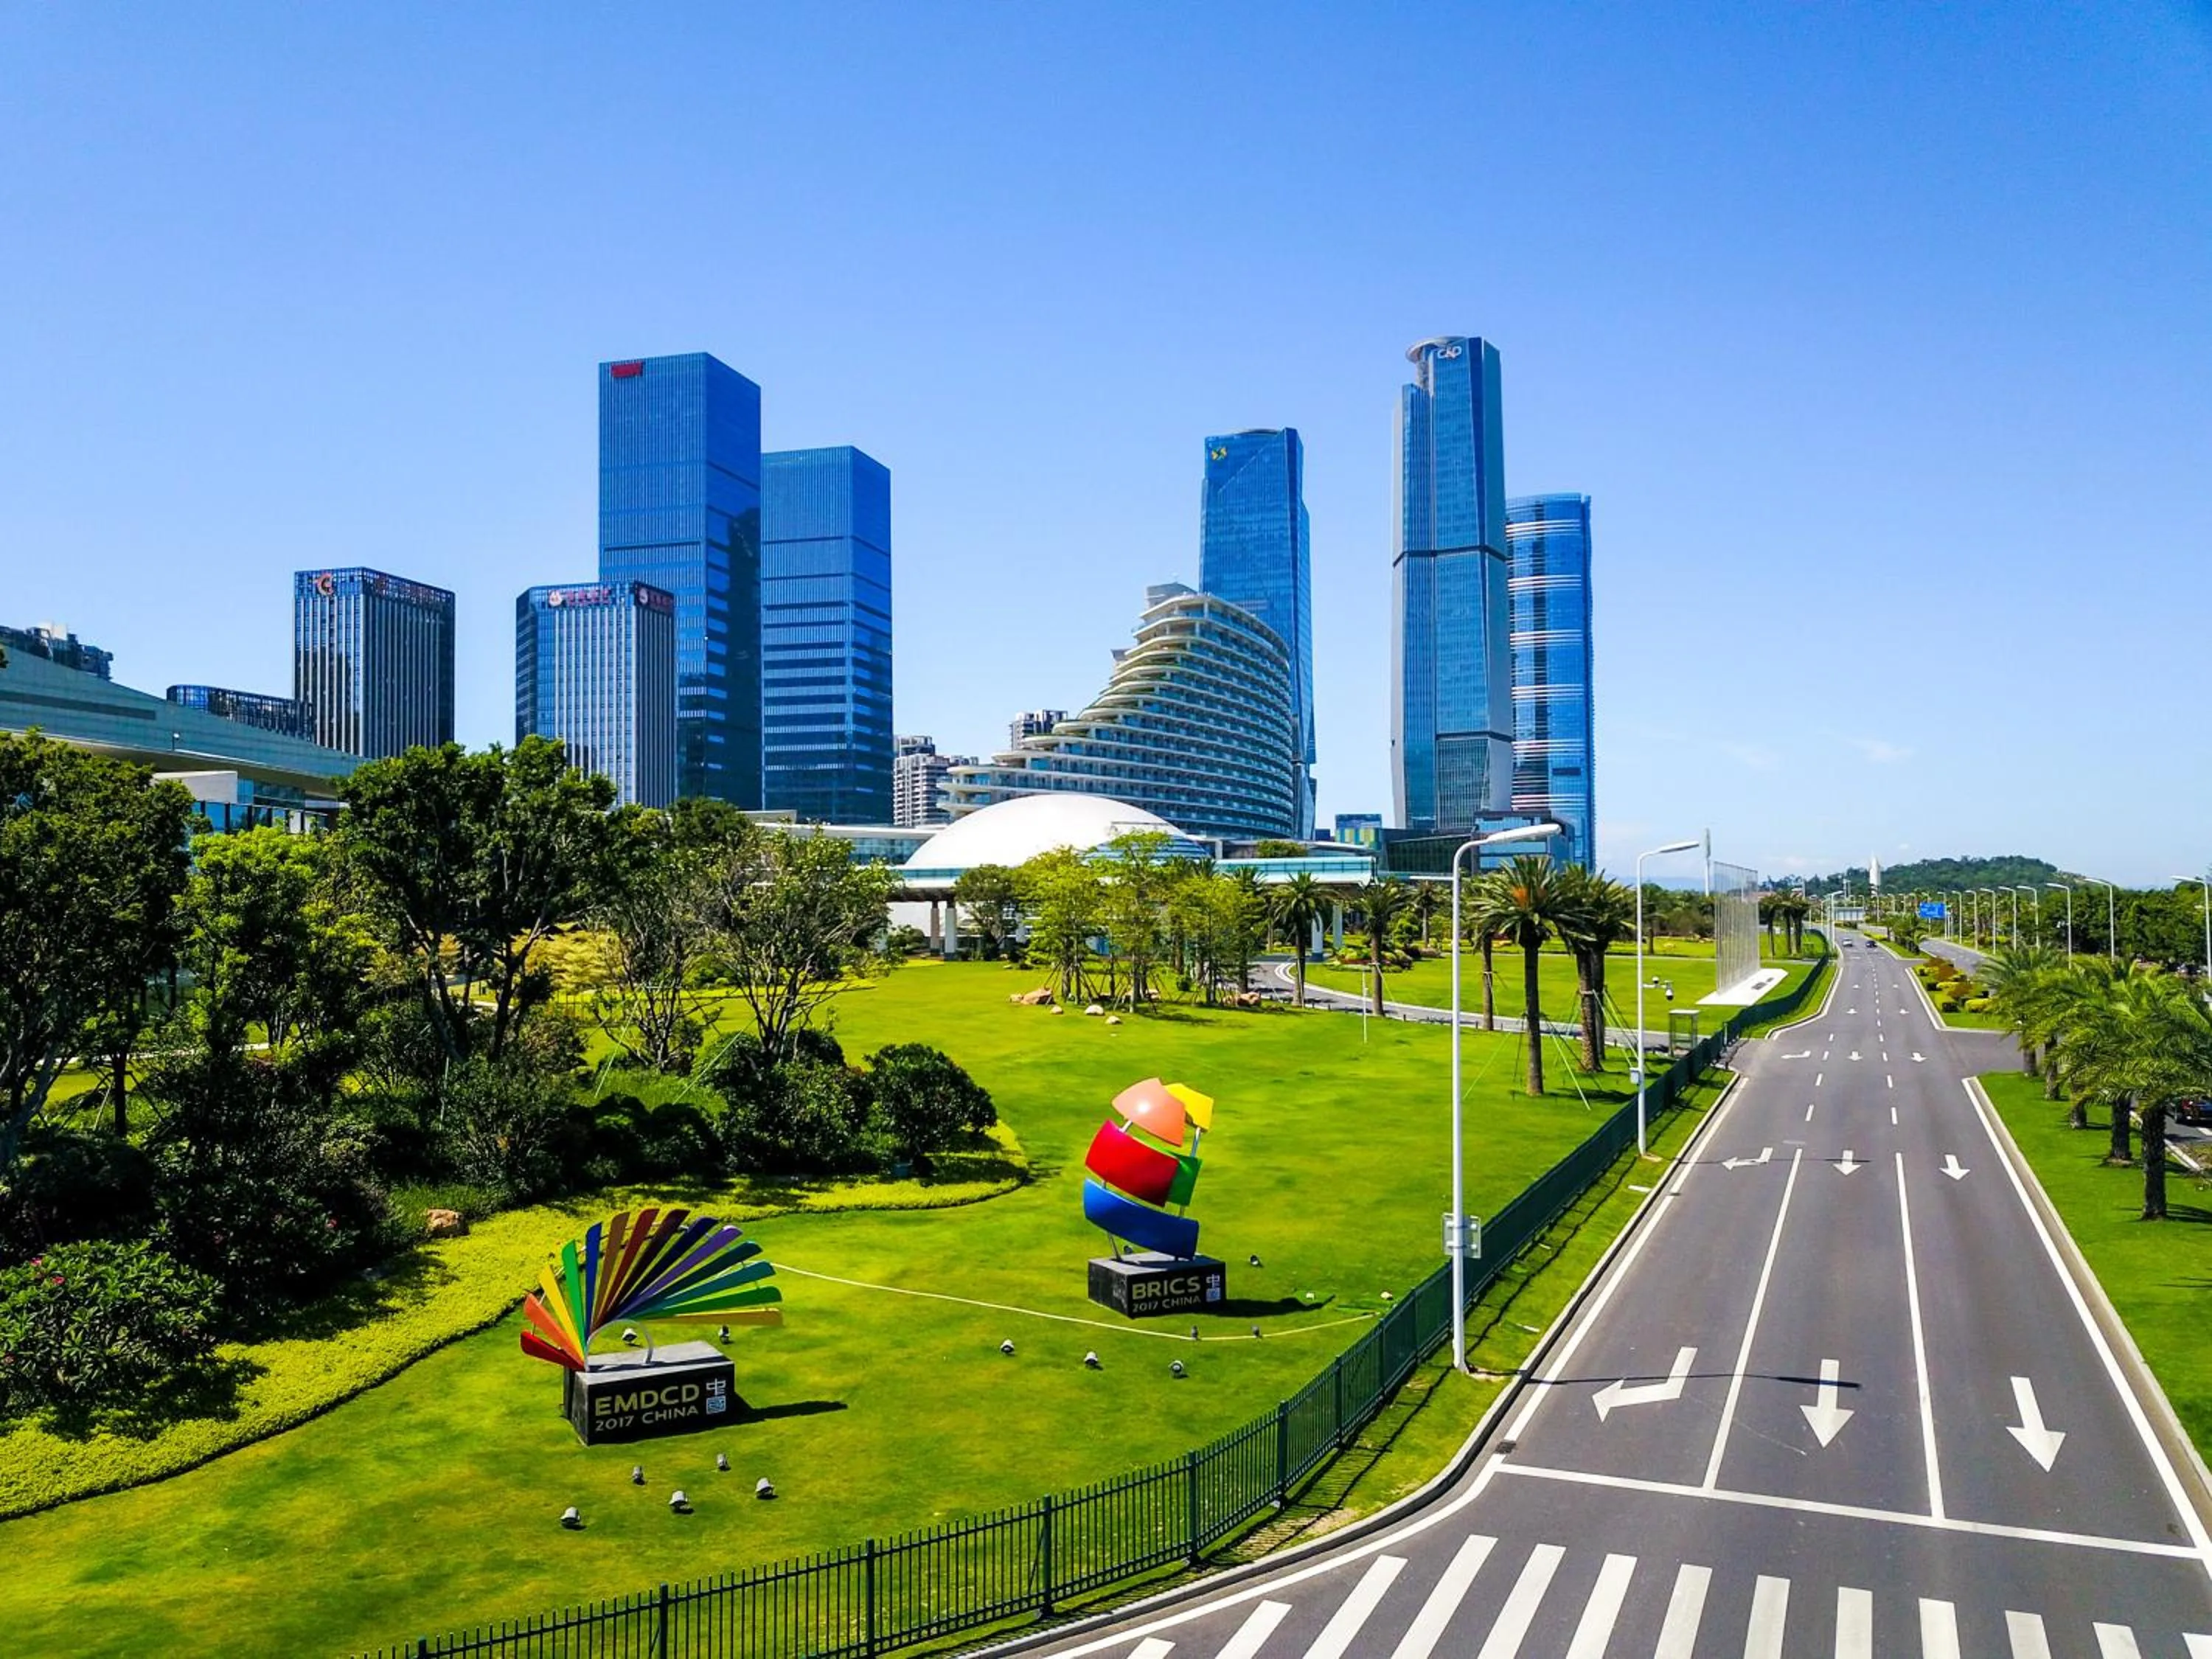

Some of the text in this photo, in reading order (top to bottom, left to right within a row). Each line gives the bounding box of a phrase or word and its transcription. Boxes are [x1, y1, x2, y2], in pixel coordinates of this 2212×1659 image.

[1132, 1276, 1201, 1300] BRICS
[1132, 1295, 1201, 1312] 2017 CHINA
[595, 1384, 700, 1416] EMDCD
[595, 1405, 699, 1432] 2017 CHINA
